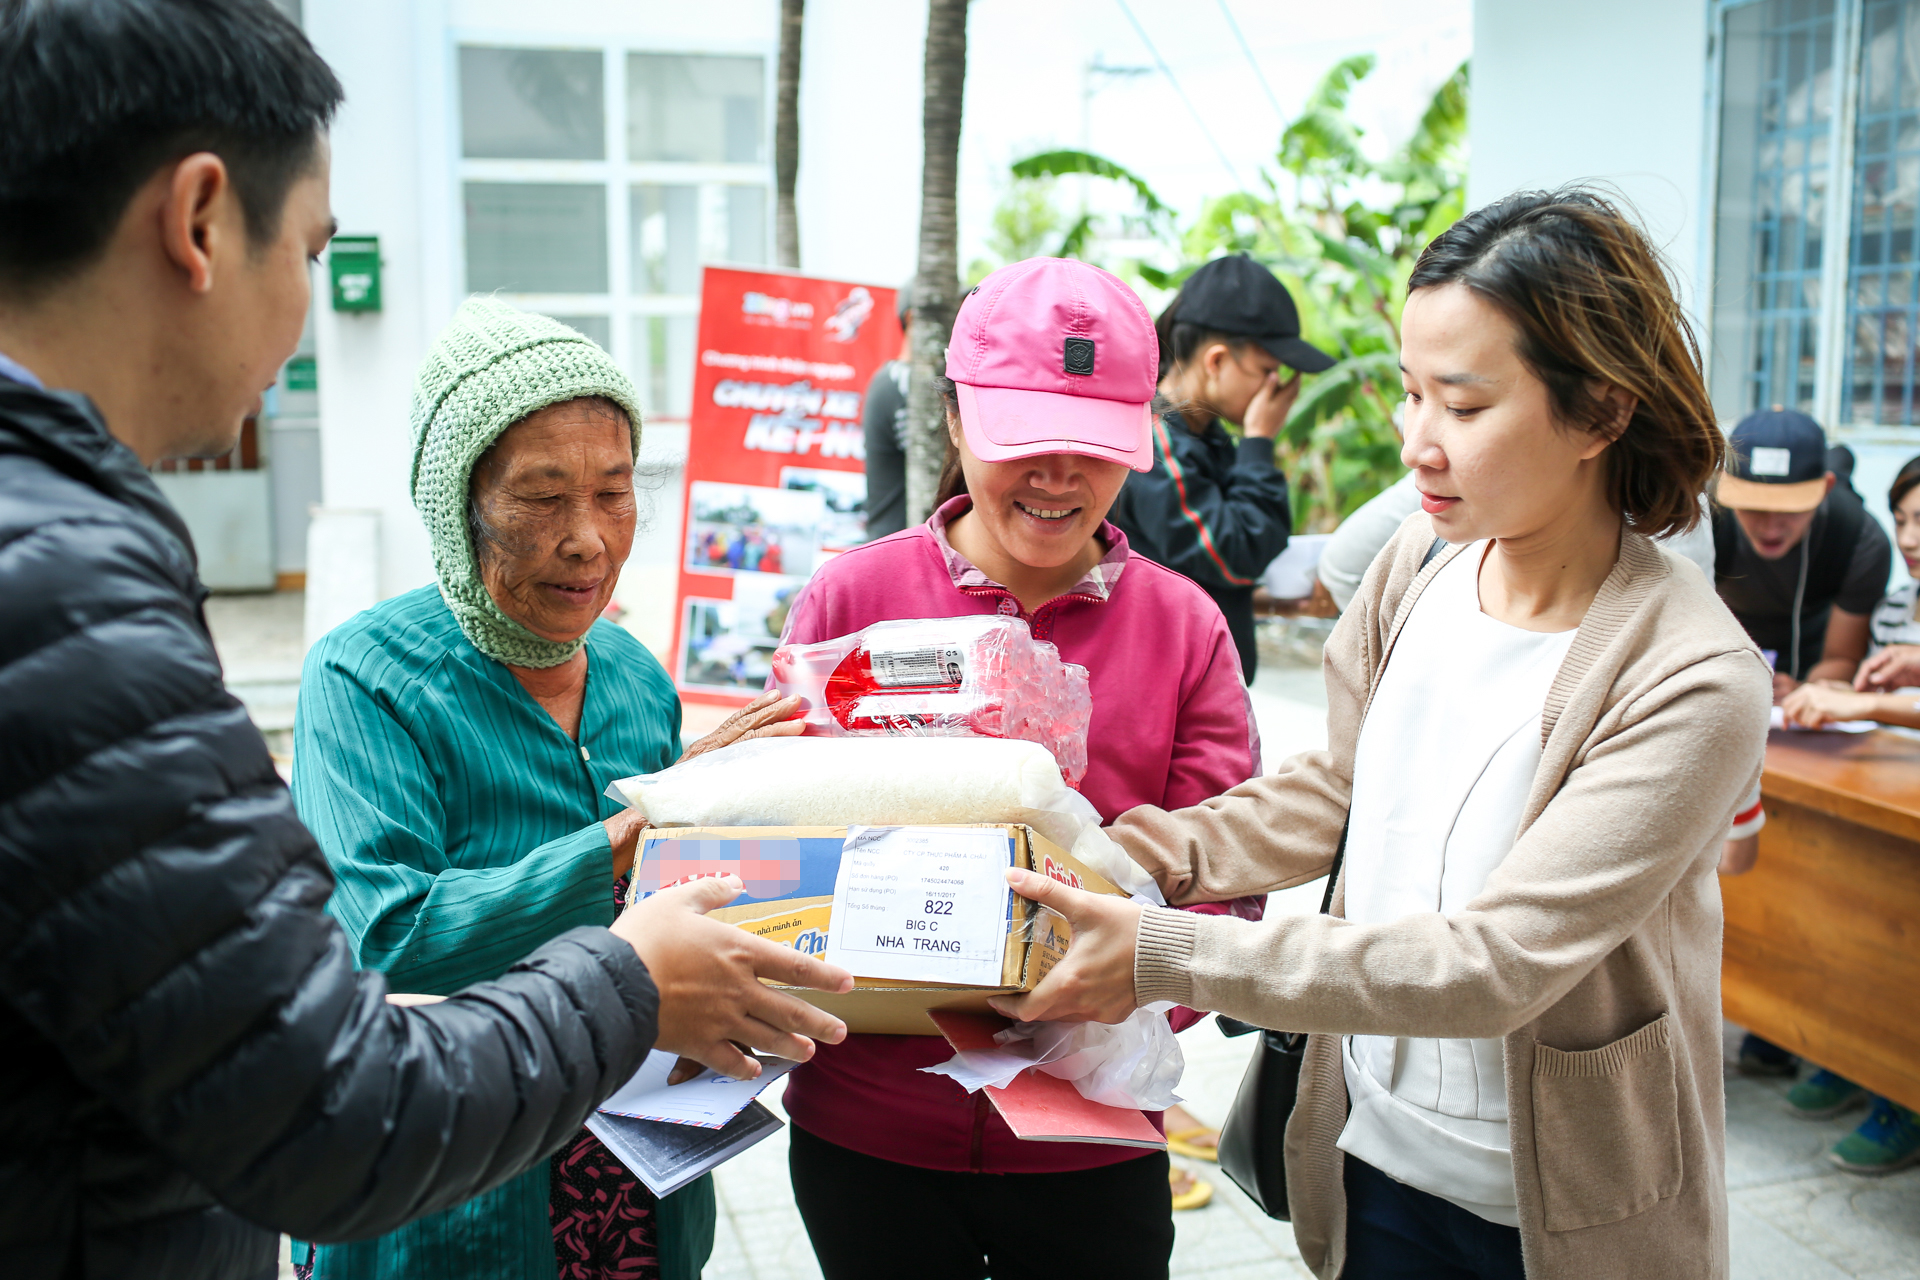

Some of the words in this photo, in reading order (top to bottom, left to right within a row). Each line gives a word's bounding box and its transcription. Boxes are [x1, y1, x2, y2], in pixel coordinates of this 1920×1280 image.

[924, 900, 954, 916] 822
[757, 925, 771, 936] nhà
[905, 919, 926, 931] BIG
[929, 921, 939, 932] C
[875, 935, 905, 949] NHA
[913, 938, 962, 953] TRANG
